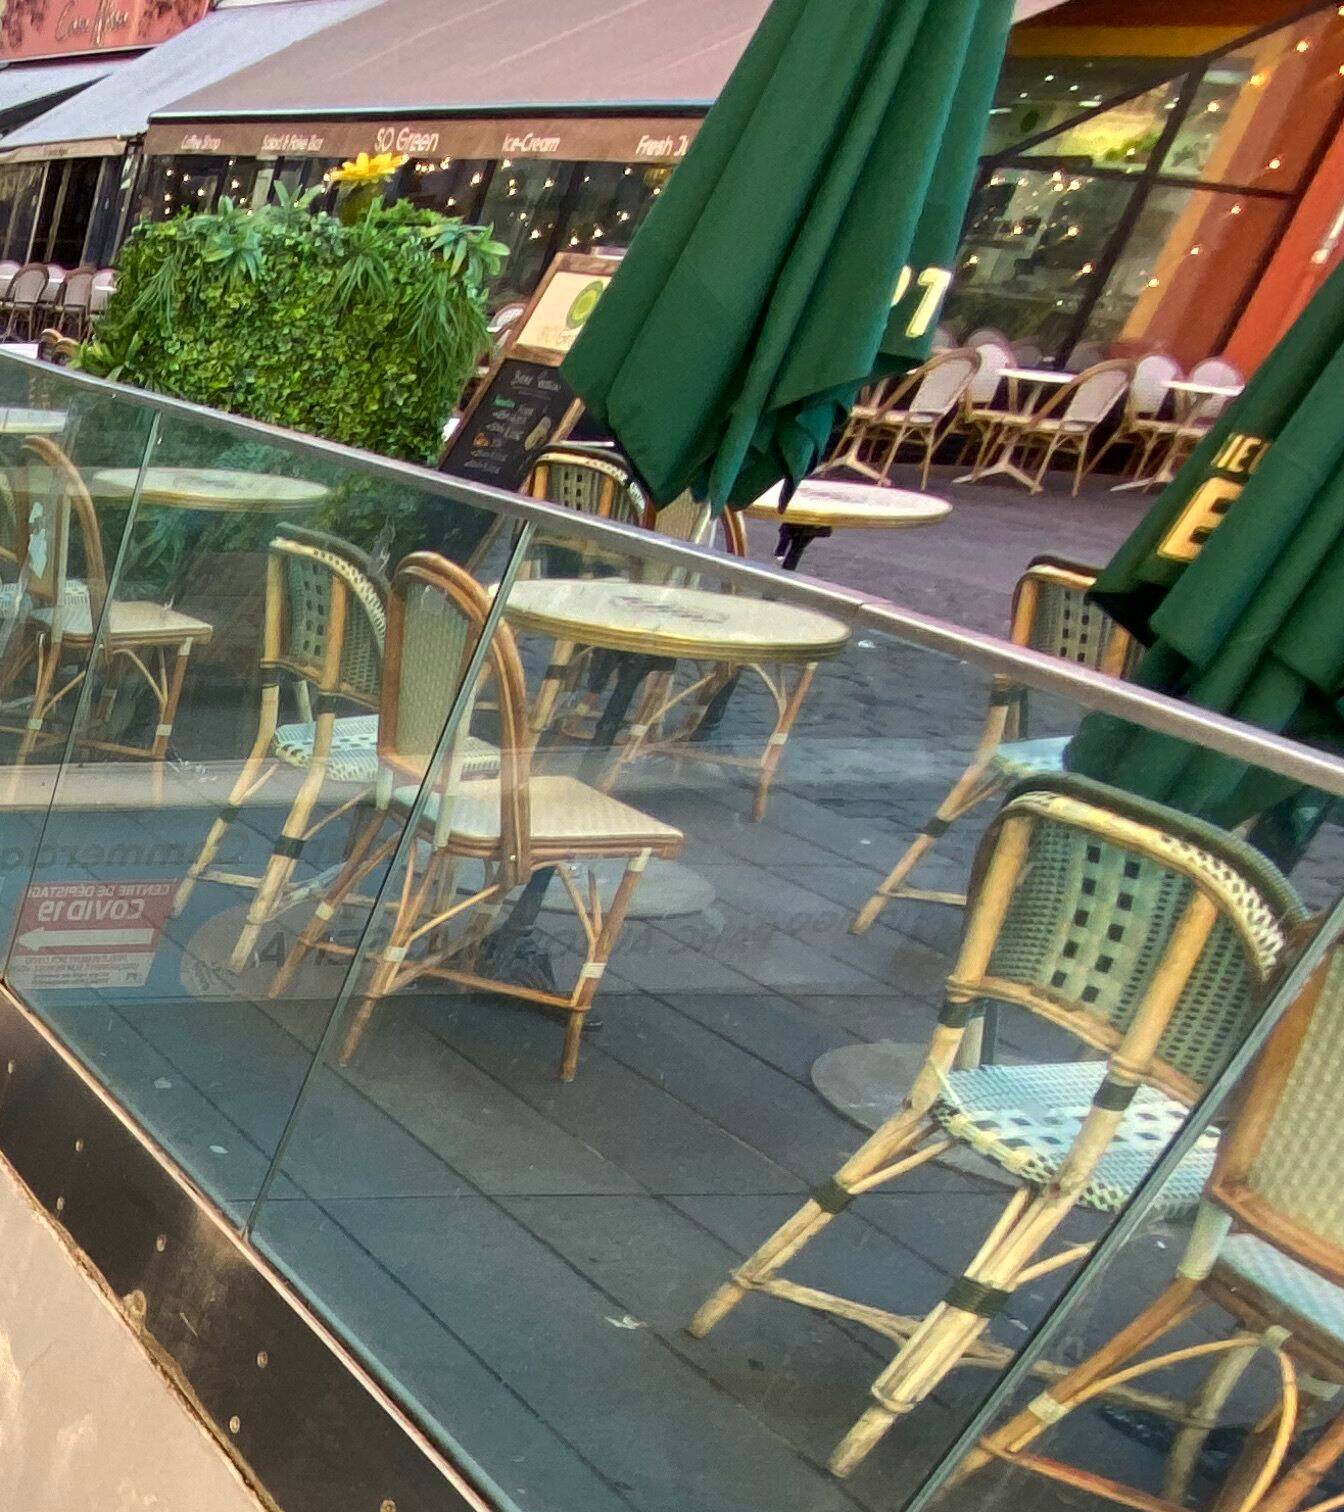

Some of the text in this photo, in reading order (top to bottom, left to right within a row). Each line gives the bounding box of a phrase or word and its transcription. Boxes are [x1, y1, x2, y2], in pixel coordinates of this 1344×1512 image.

[396, 127, 440, 152] Green
[502, 132, 560, 153] Ice-Cream
[635, 135, 673, 156] Fresh
